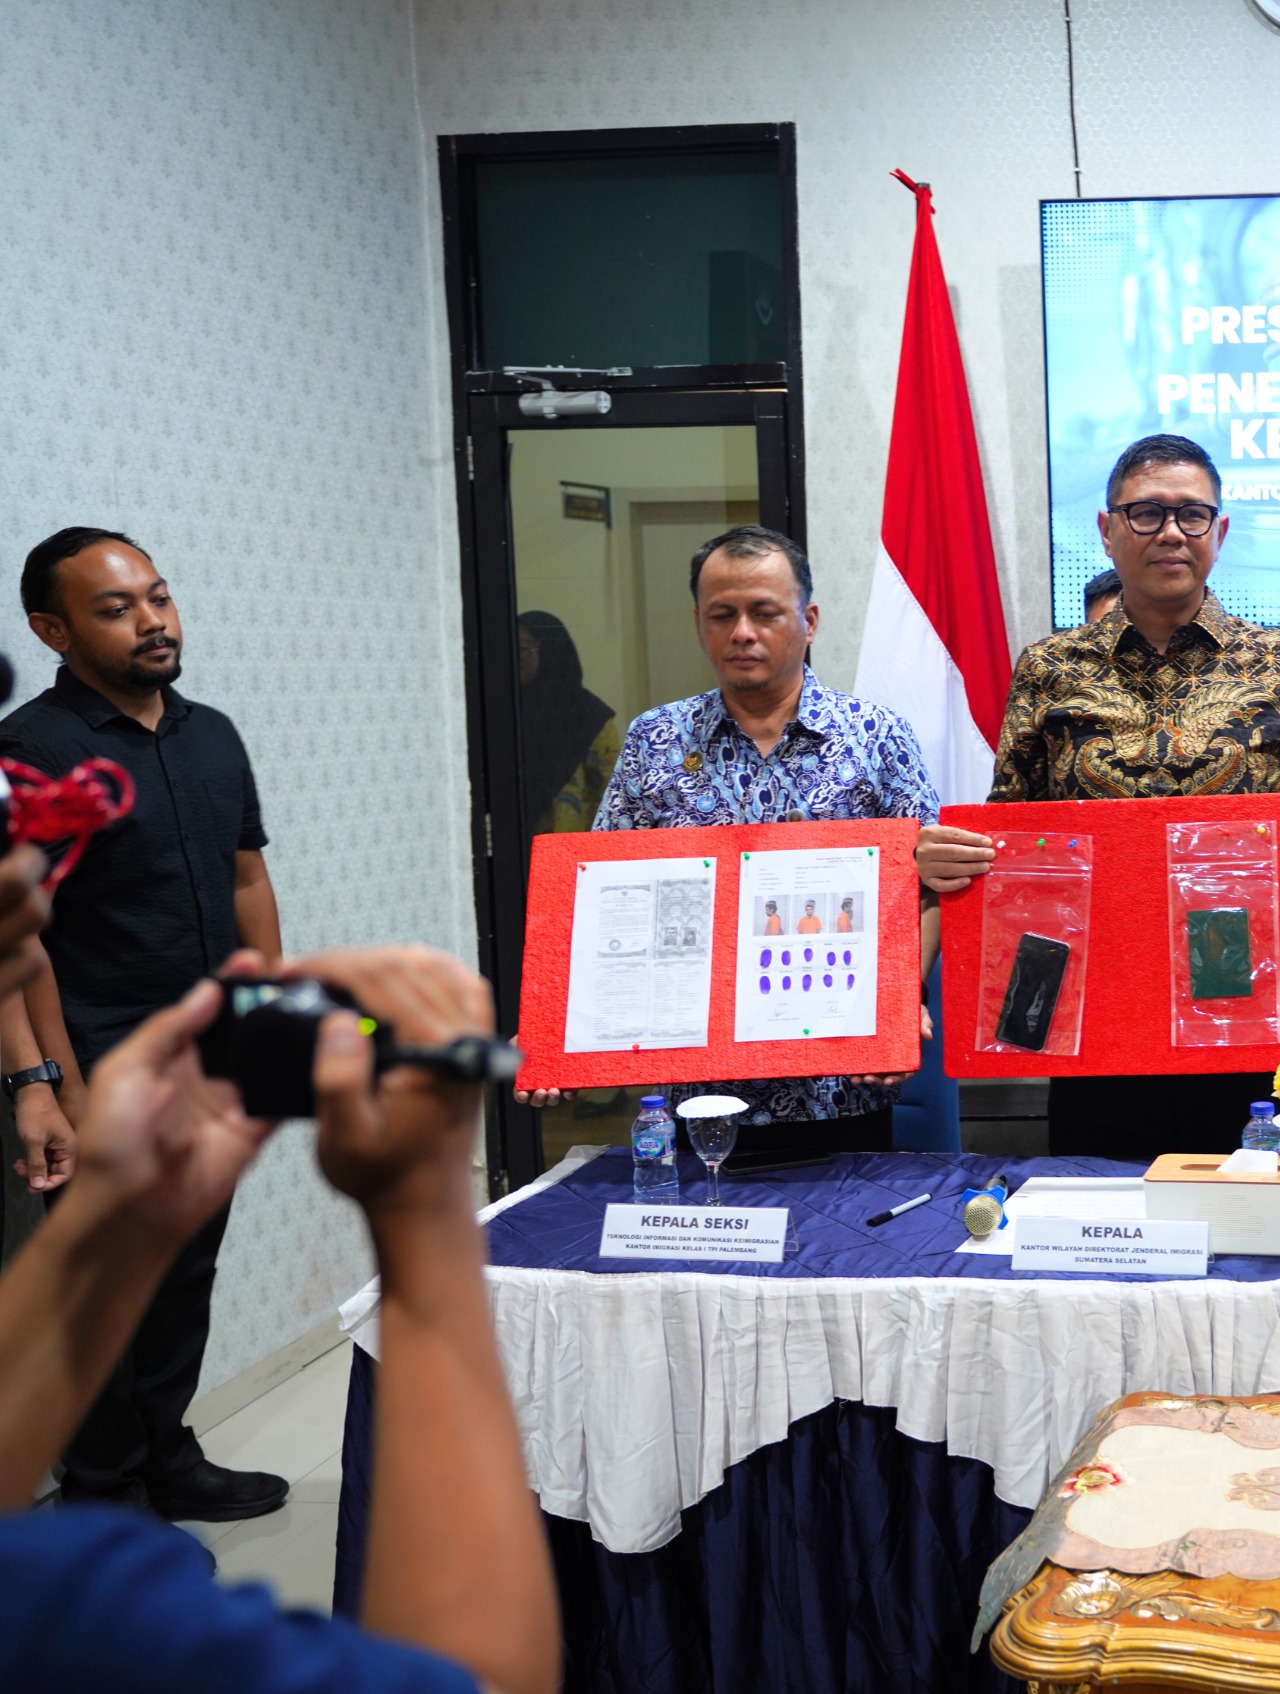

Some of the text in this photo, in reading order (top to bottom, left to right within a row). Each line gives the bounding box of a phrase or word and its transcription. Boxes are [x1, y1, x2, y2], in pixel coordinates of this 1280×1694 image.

[640, 1215, 749, 1230] KEPALA SEKSI
[1082, 1226, 1143, 1239] KEPALA
